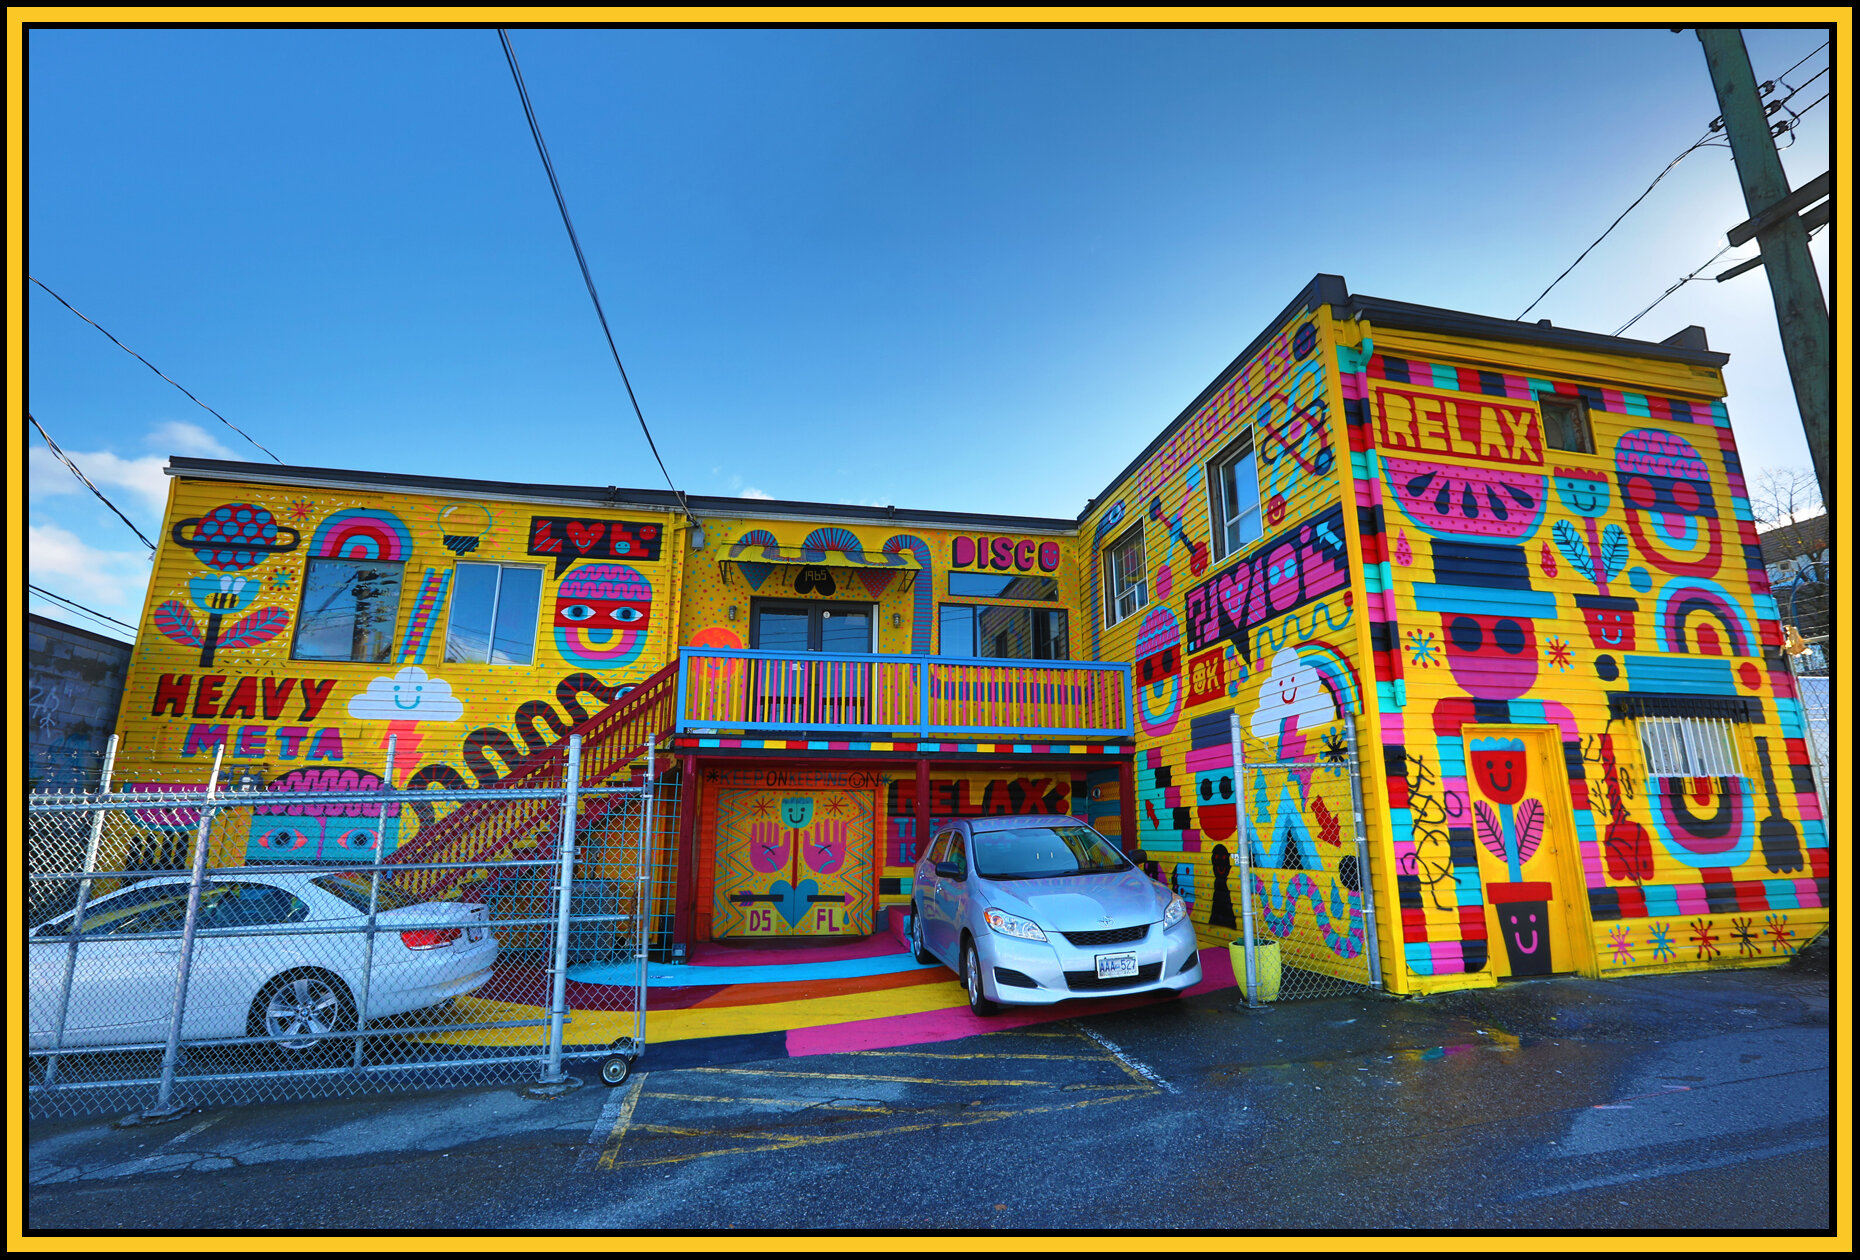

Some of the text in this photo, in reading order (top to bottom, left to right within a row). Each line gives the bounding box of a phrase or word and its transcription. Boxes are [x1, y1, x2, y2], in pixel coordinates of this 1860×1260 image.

[1382, 392, 1540, 463] RELAX
[952, 535, 1060, 573] DISCO
[804, 570, 827, 581] 1965
[1192, 656, 1221, 695] OK
[151, 673, 338, 722] HEAVY
[181, 723, 344, 762] META
[720, 769, 764, 786] KEEP
[766, 770, 788, 787] ON
[789, 770, 848, 787] KEEPING
[816, 908, 841, 933] FL
[1120, 958, 1136, 971] 527
